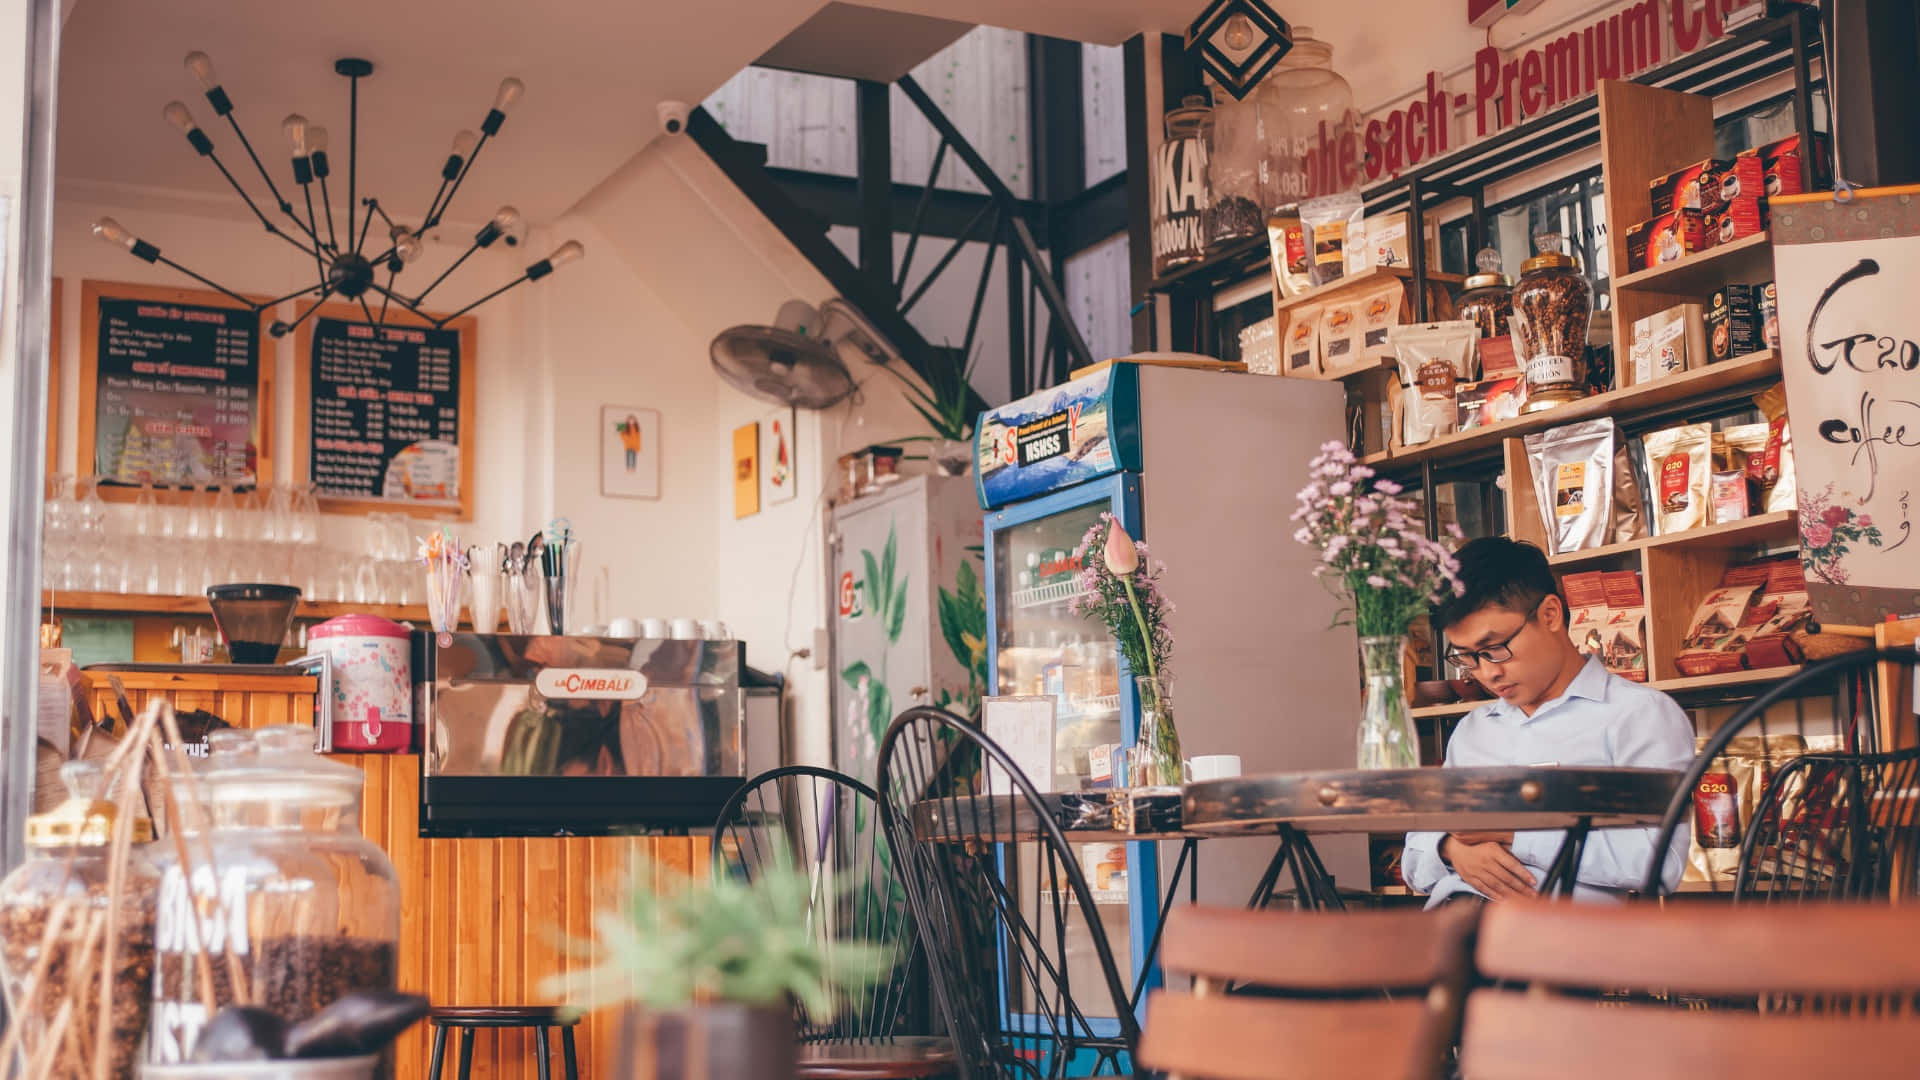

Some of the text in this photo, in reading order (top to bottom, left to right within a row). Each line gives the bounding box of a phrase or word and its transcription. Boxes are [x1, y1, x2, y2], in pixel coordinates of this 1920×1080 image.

[1476, 0, 1661, 137] Premium
[566, 674, 631, 693] CIMBALI
[1700, 783, 1727, 793] G20
